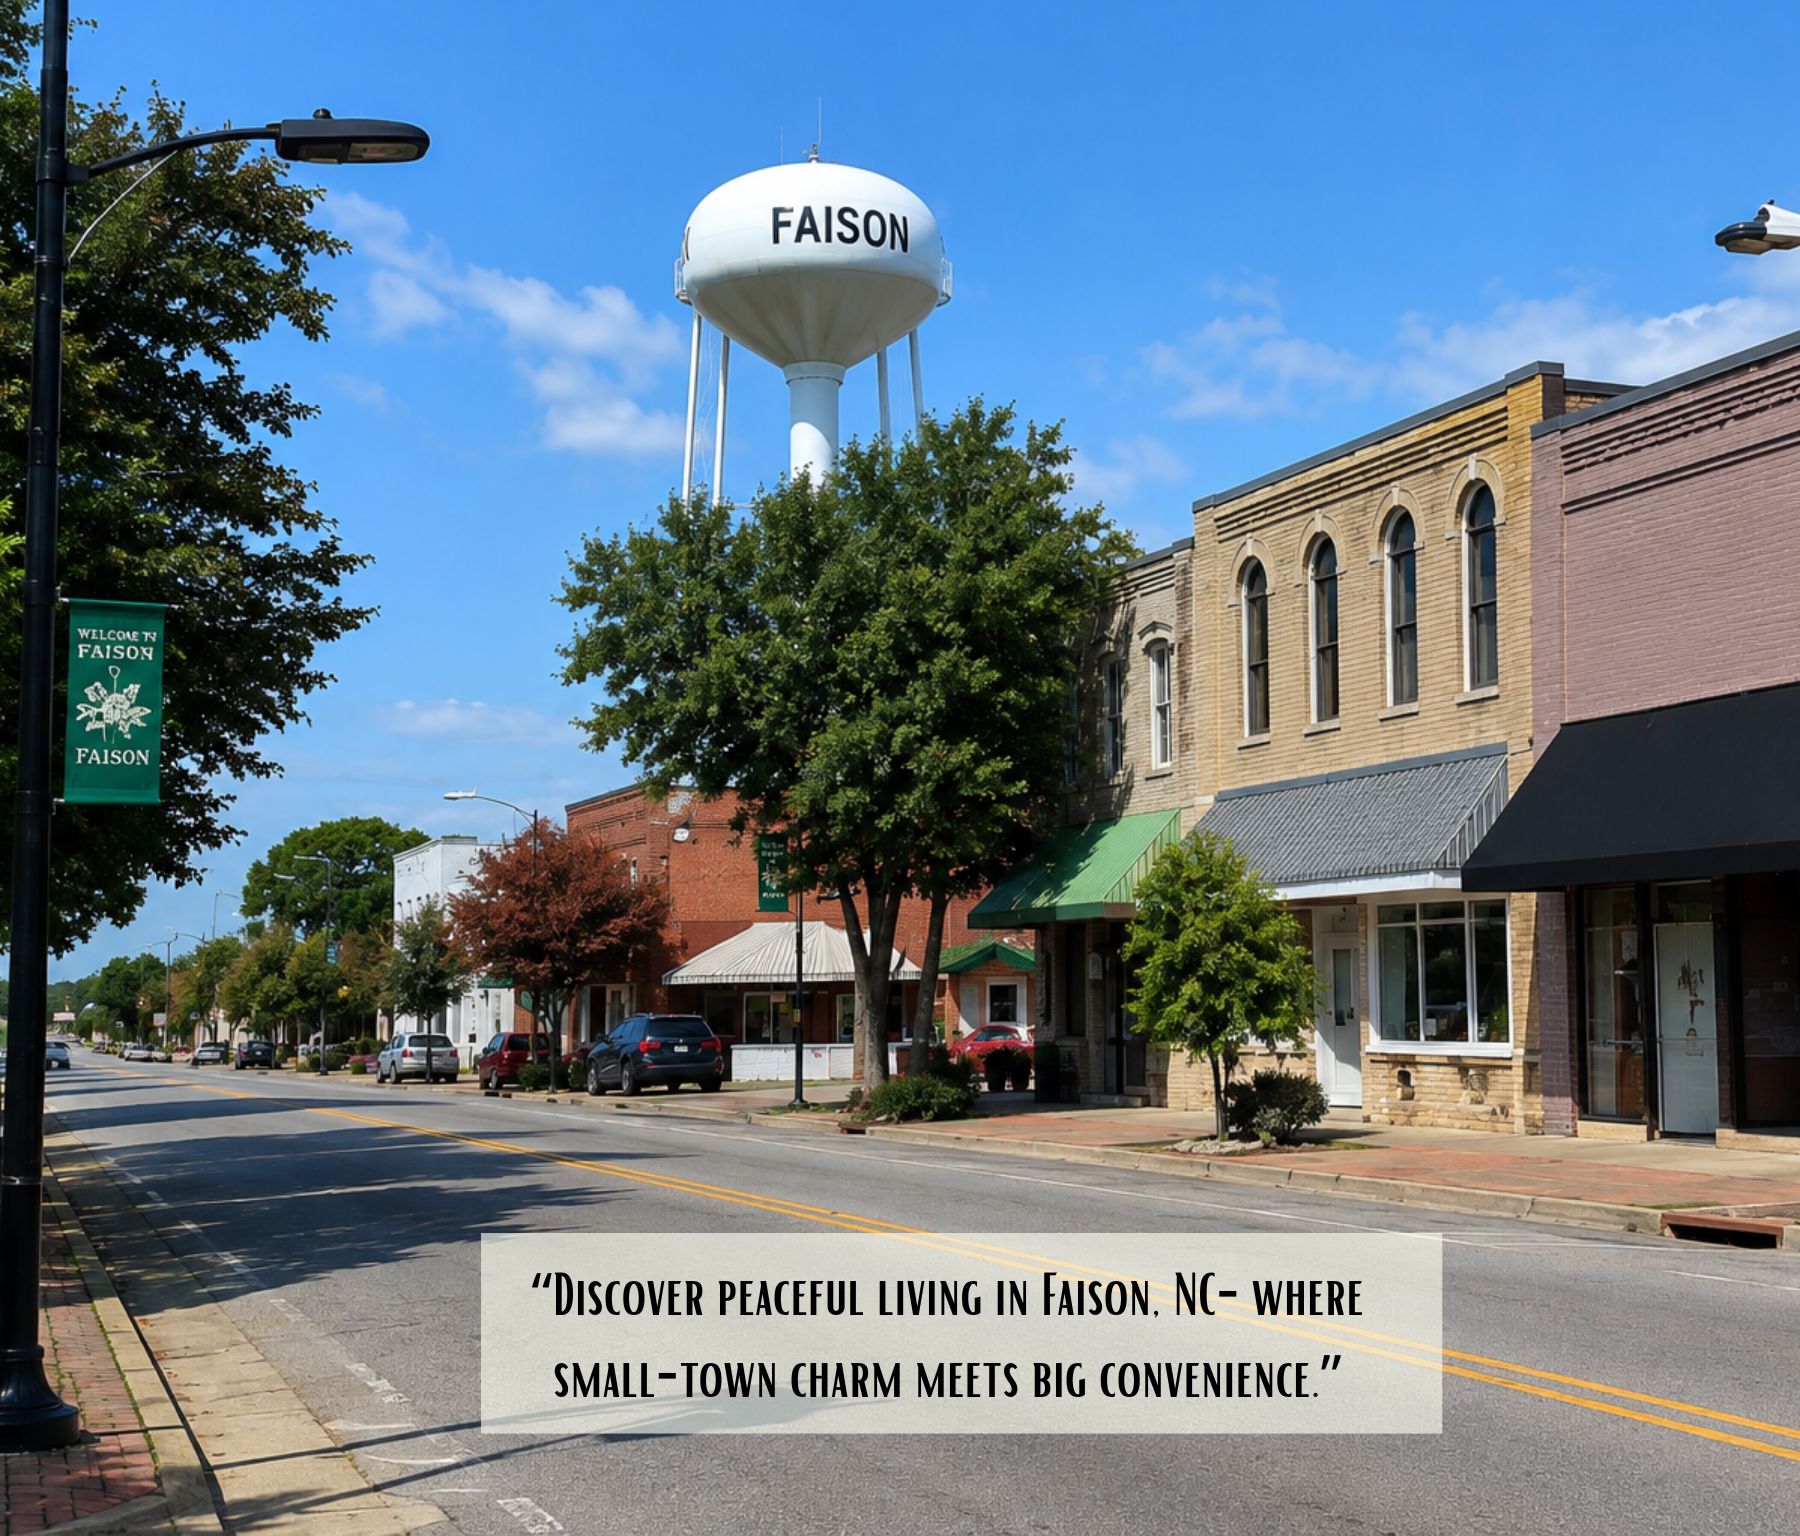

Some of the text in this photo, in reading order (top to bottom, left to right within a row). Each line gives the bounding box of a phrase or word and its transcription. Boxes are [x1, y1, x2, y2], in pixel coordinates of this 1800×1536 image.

[772, 206, 909, 254] FAISON
[78, 643, 154, 661] FAISON
[75, 748, 150, 766] FAISON
